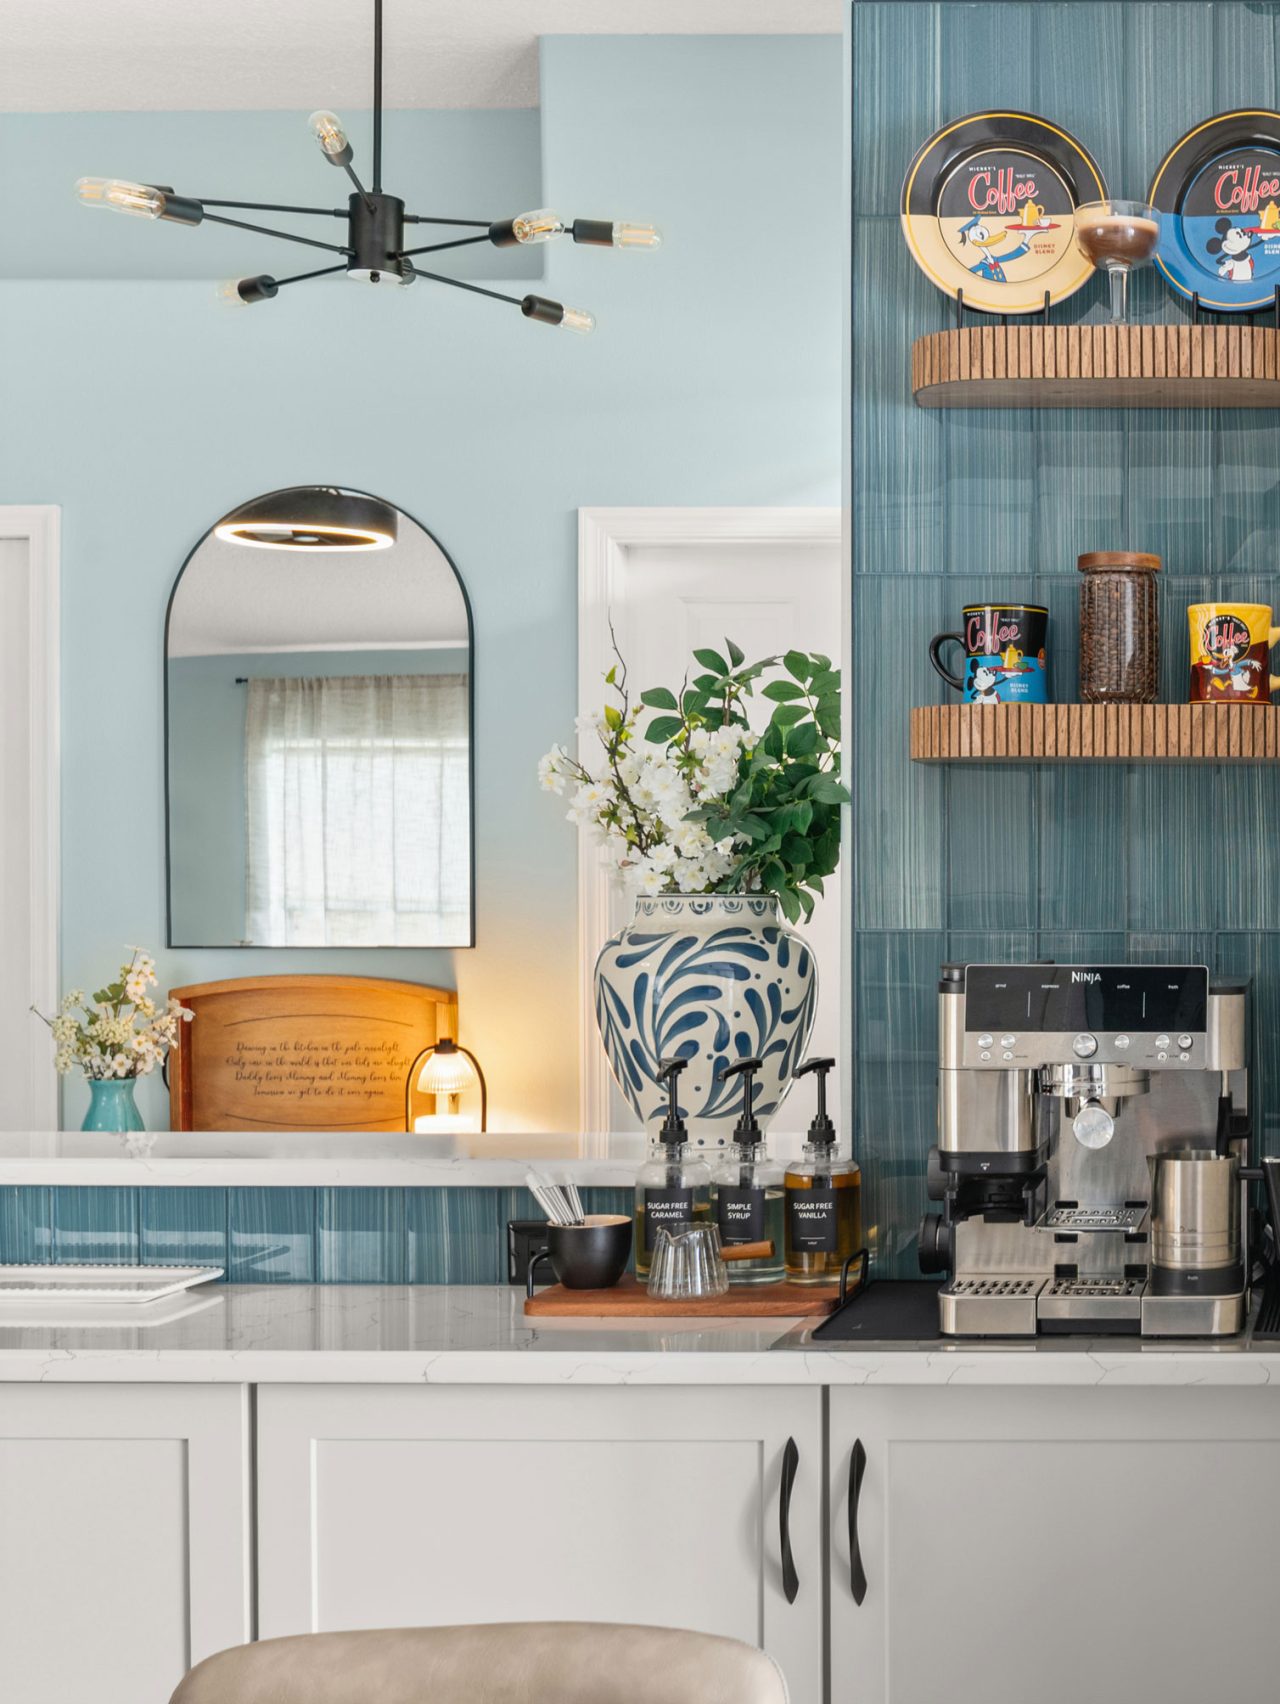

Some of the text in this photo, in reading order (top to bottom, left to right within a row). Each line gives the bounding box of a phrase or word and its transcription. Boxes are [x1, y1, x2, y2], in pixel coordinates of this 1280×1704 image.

[967, 167, 1039, 214] Coffee
[967, 611, 1021, 655] Coffee
[1205, 622, 1250, 652] Coffee
[1071, 970, 1102, 985] NINJA
[647, 1202, 670, 1210] SUGAR
[793, 1202, 815, 1210] SUGAR
[650, 1211, 685, 1219] CARAMEL
[727, 1212, 751, 1220] SYRUP
